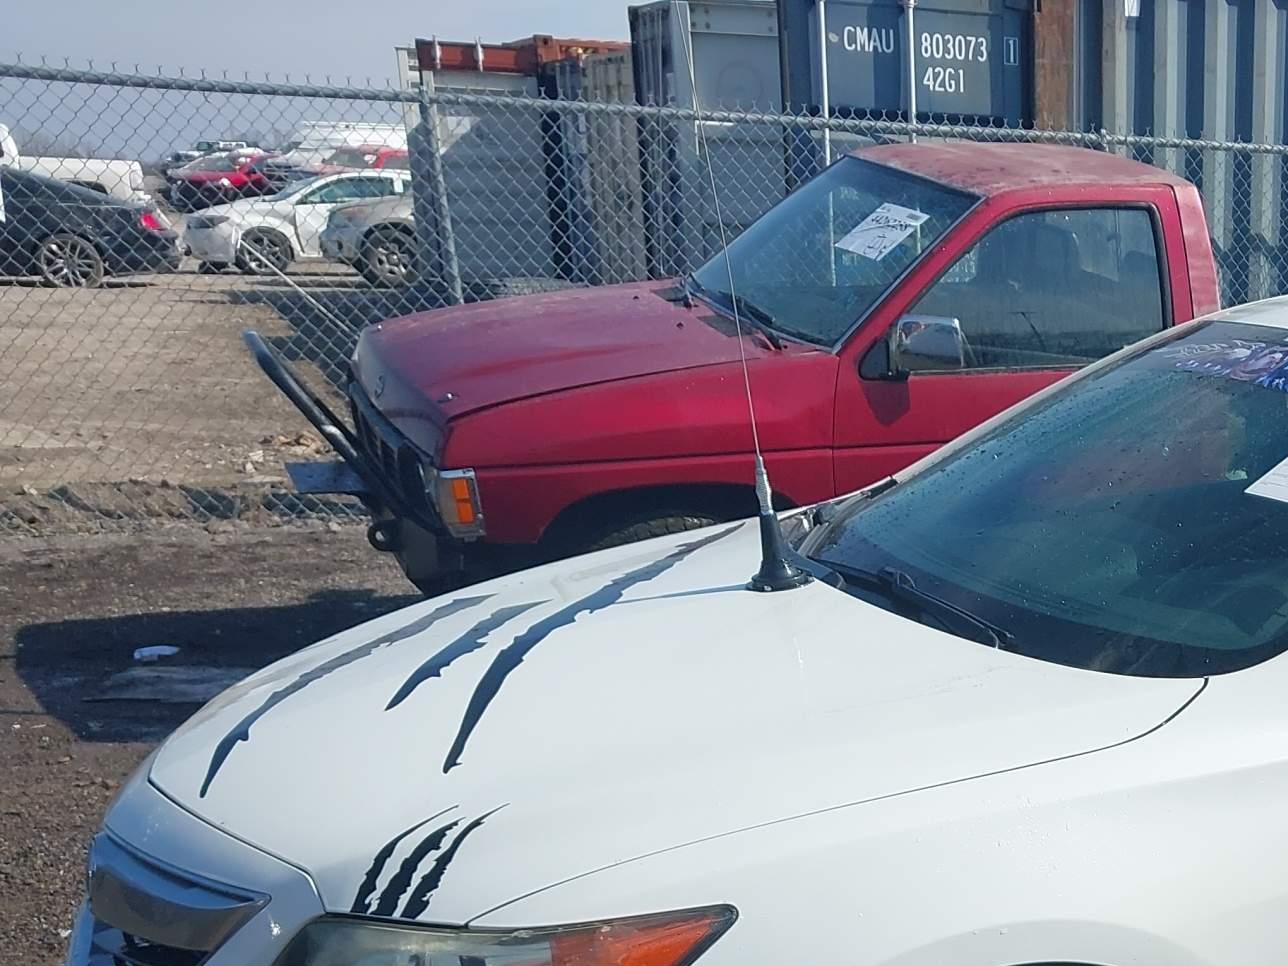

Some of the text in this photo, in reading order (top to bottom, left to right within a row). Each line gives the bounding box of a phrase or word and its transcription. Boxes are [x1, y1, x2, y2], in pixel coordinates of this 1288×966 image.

[843, 25, 894, 53] CMAU
[920, 32, 988, 63] 803073
[923, 67, 965, 93] 42G1
